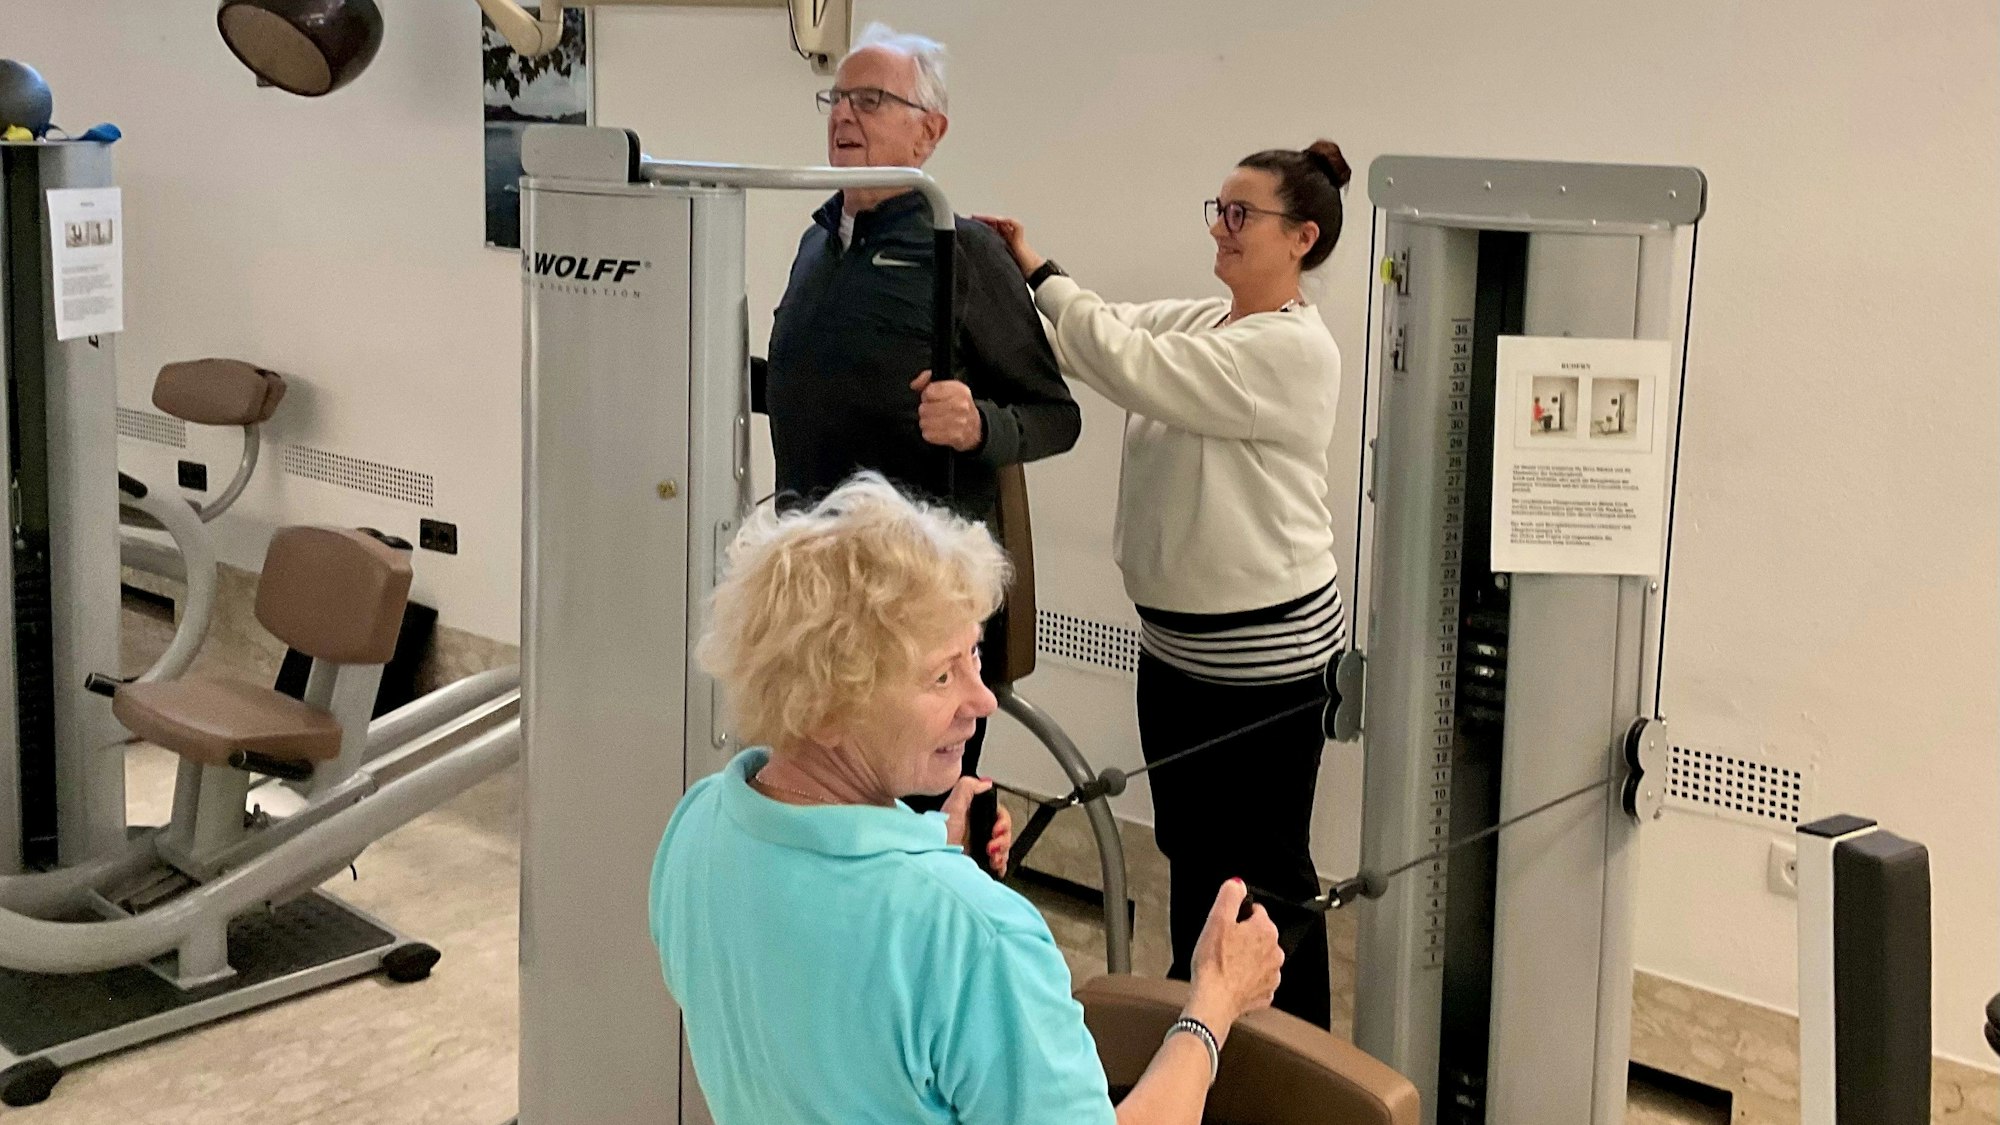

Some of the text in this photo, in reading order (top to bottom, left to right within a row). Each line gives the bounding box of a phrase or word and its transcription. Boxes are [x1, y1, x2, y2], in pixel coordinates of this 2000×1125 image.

[1453, 343, 1467, 355] 34
[1452, 380, 1465, 392] 32
[1450, 400, 1464, 411] 31
[1450, 419, 1464, 430] 30
[1447, 474, 1460, 486] 27
[1443, 568, 1456, 580] 22
[1442, 586, 1455, 599] 21
[1442, 606, 1455, 617] 20
[1442, 624, 1454, 635] 19
[1441, 642, 1453, 654] 18
[1440, 660, 1452, 672] 17
[1440, 679, 1451, 690] 16
[1438, 697, 1450, 709] 15
[1438, 715, 1449, 726] 14
[1437, 734, 1449, 746] 13
[1436, 752, 1448, 764] 12
[1436, 770, 1446, 781] 11
[1434, 788, 1446, 800] 10
